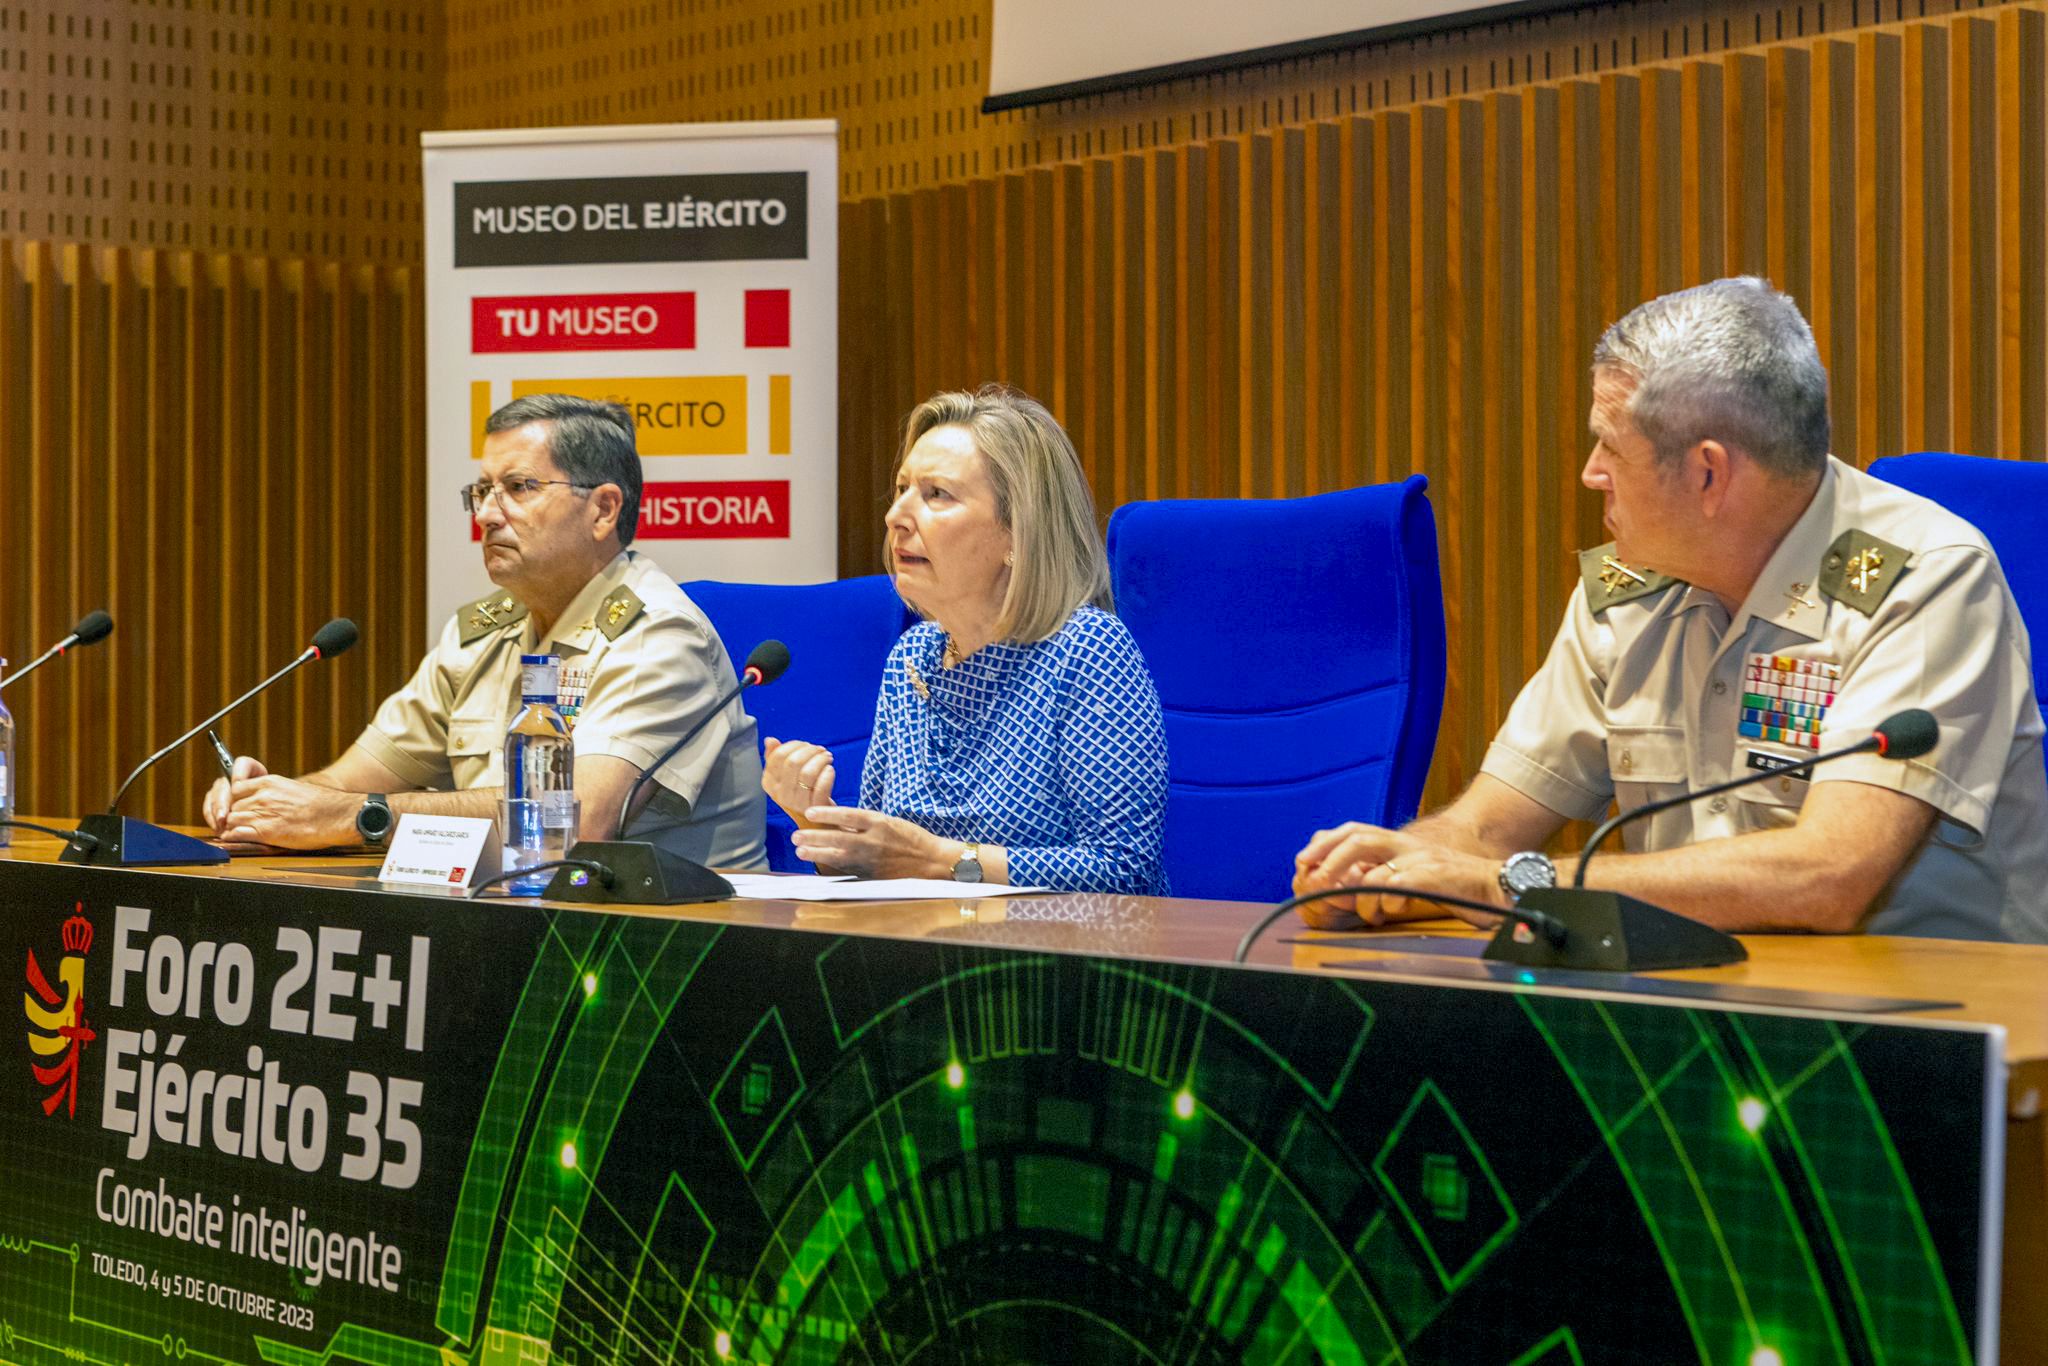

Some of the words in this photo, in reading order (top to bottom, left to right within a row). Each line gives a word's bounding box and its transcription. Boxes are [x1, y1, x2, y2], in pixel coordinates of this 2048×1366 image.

[473, 204, 577, 234] MUSEO
[583, 202, 638, 231] DEL
[643, 195, 787, 230] EJÉRCITO
[497, 309, 540, 337] TU
[547, 305, 659, 337] MUSEO
[622, 396, 726, 429] RCITO
[639, 495, 775, 526] HISTORIA
[108, 905, 255, 1026] Foro
[101, 1028, 329, 1173] Ejército
[340, 1070, 424, 1190] 35
[96, 1168, 224, 1249] Combate
[230, 1194, 402, 1292] inteligente
[91, 1252, 148, 1291] TOLEDO,
[149, 1270, 160, 1290] 4
[161, 1275, 171, 1298] y
[173, 1275, 182, 1296] 5
[185, 1277, 205, 1303] DE
[207, 1283, 275, 1322] OCTUBRE
[278, 1301, 315, 1332] 2023
